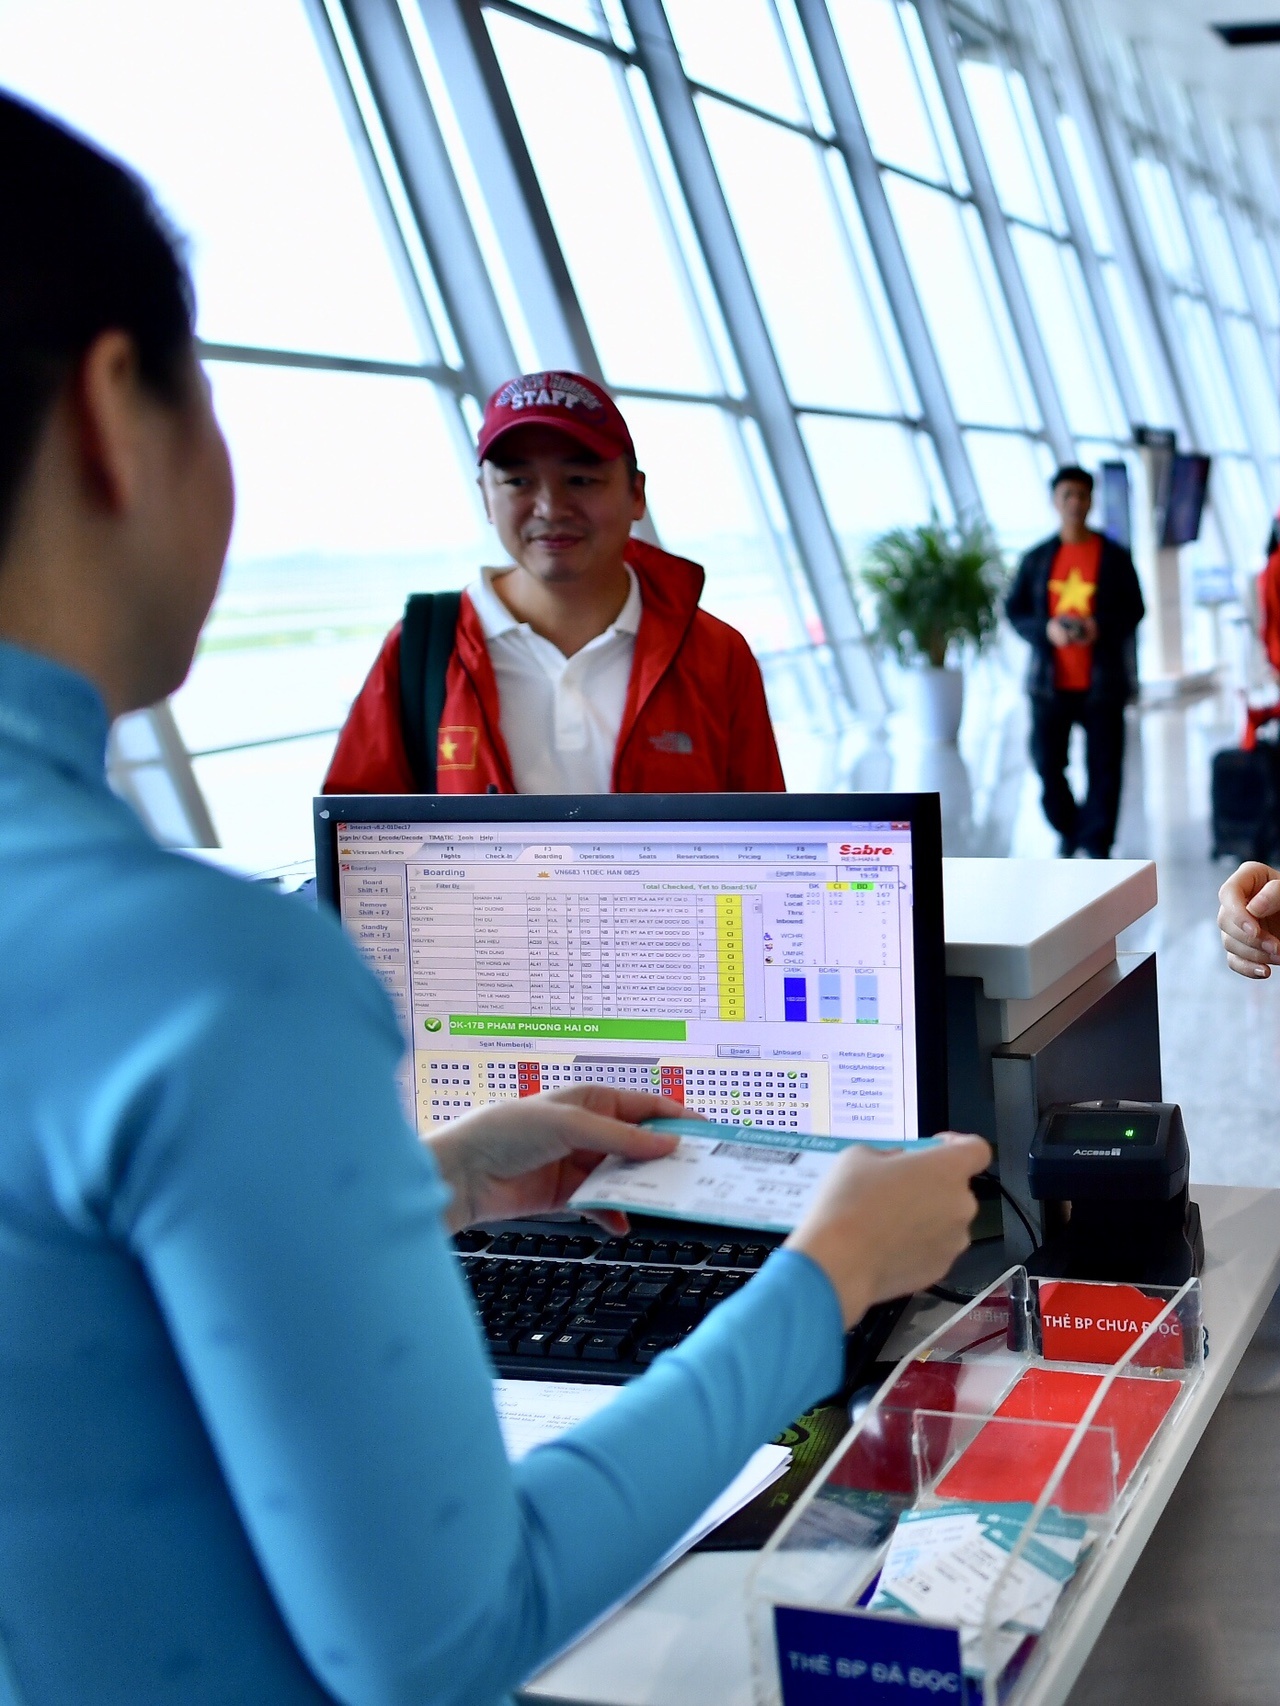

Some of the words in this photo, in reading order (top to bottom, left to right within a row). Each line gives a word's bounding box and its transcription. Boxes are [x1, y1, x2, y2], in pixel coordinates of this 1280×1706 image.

[512, 390, 580, 411] STAFF
[839, 845, 893, 855] Sabre
[424, 869, 465, 877] Boarding
[518, 1023, 561, 1031] PHUONG
[1043, 1313, 1071, 1328] THẺ
[1075, 1318, 1092, 1329] BP
[1097, 1319, 1138, 1332] CHƯA
[788, 1651, 831, 1676] THẺ
[836, 1658, 867, 1679] BP
[909, 1666, 960, 1695] ĐỌC
